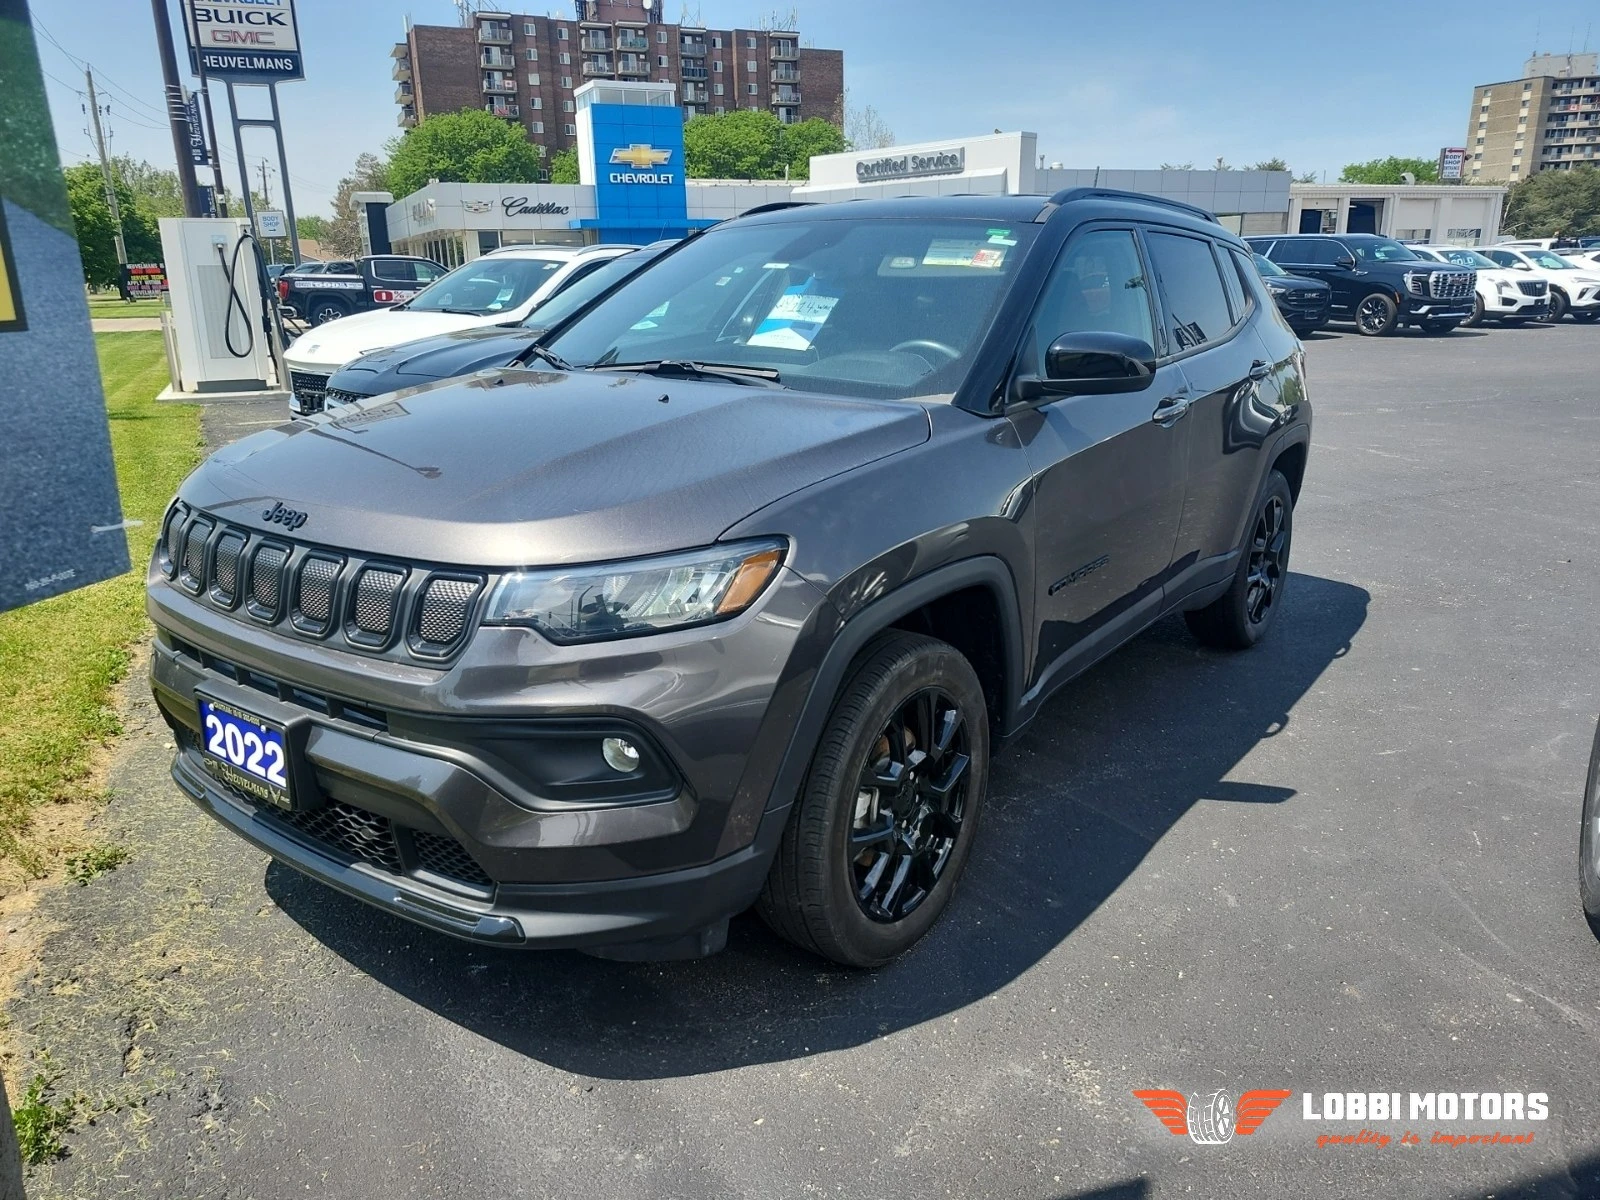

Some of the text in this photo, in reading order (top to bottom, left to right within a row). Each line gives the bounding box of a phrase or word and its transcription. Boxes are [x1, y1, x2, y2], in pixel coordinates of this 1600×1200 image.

[195, 8, 287, 25] BUICK
[211, 29, 275, 45] GMC
[856, 152, 958, 176] Certified Service
[609, 173, 674, 184] CHEVROLET
[501, 196, 569, 217] Cadillac
[262, 502, 308, 531] Jeep
[206, 714, 286, 787] 2022
